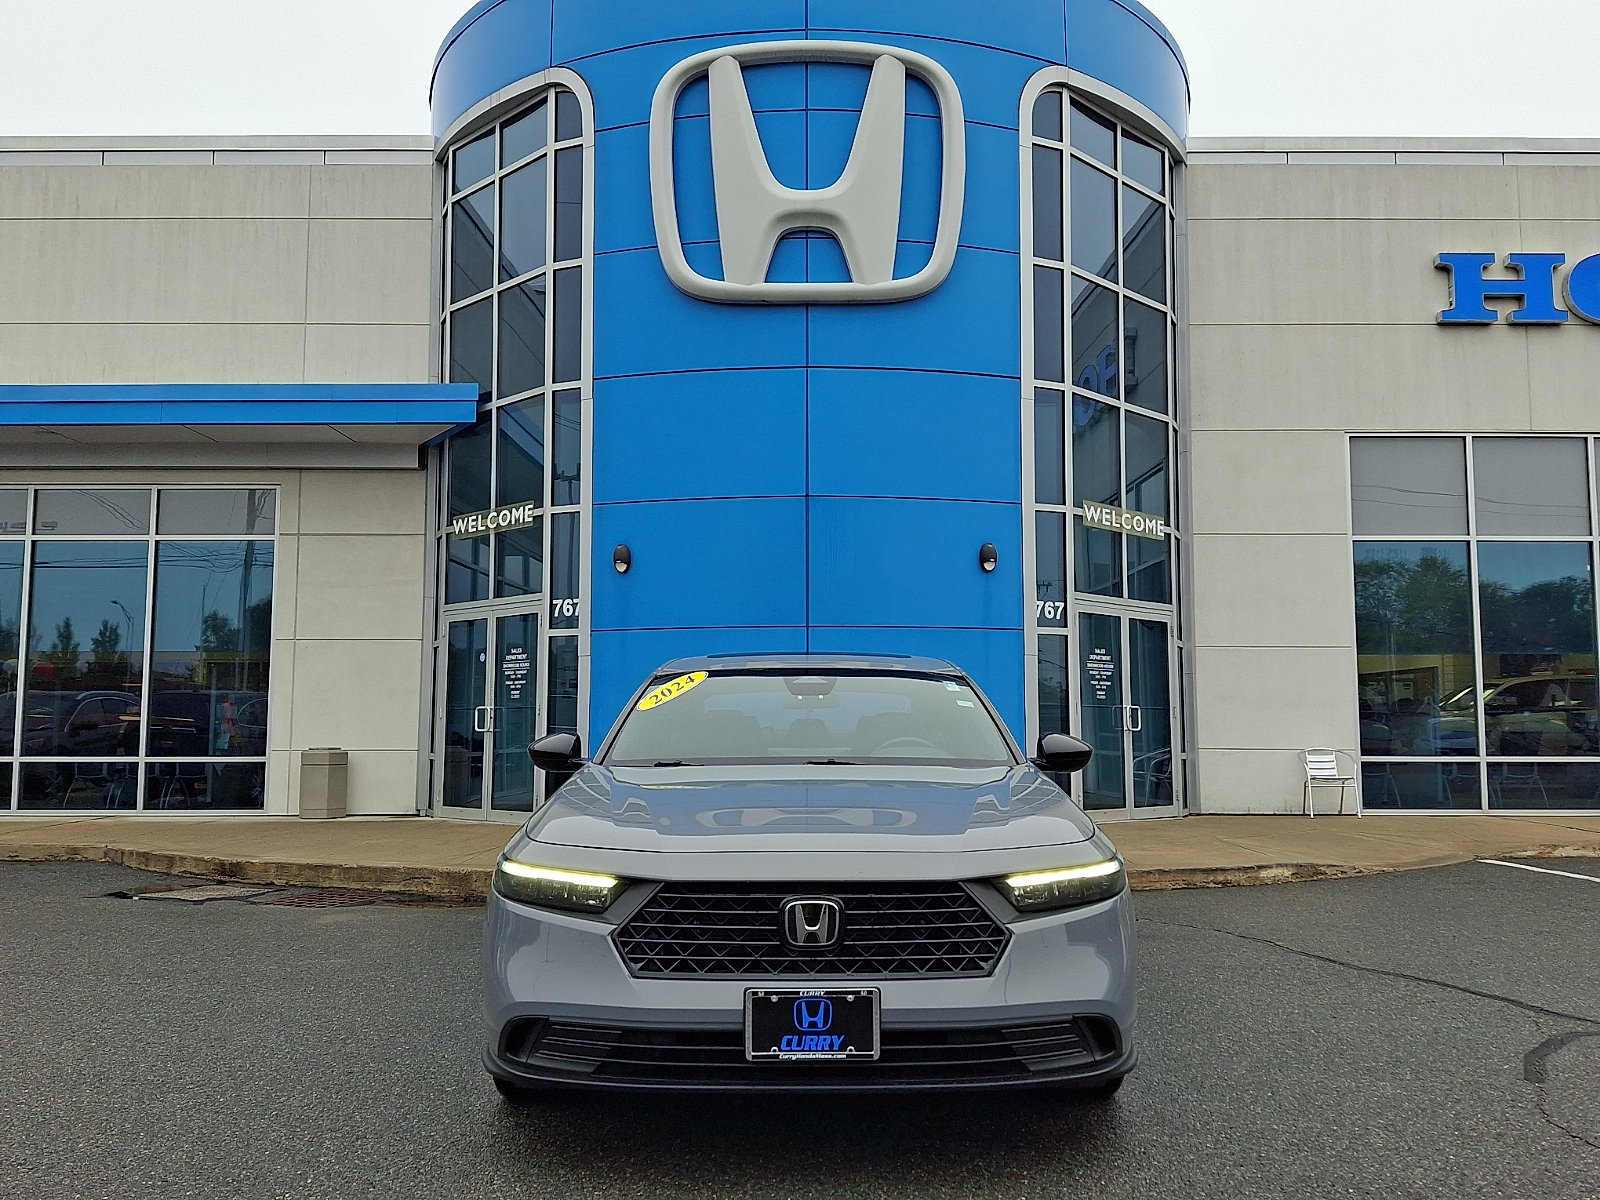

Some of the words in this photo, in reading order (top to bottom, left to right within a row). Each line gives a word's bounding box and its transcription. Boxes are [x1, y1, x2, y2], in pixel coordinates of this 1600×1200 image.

[453, 504, 534, 535] WELCOME
[1083, 504, 1164, 537] WELCOME
[552, 598, 580, 617] 767
[1036, 601, 1064, 620] 767
[649, 675, 695, 704] 2024
[780, 1034, 845, 1051] CURRY
